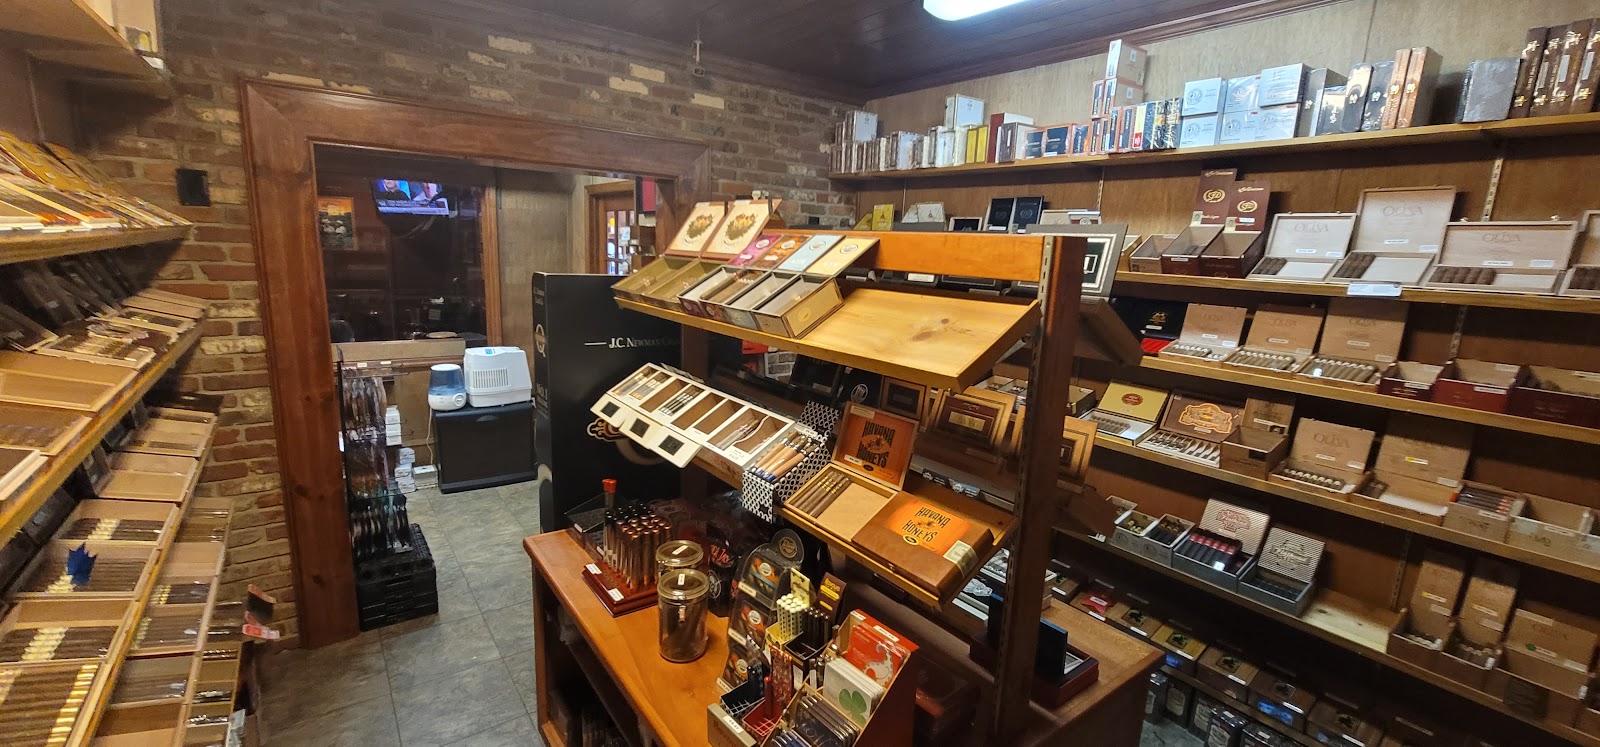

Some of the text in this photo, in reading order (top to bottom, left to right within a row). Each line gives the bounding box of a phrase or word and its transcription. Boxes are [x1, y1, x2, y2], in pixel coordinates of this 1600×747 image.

[608, 337, 626, 349] J.C.
[861, 420, 896, 448] HAVANA
[914, 506, 951, 529] HAVANA
[901, 519, 938, 543] HONEYS
